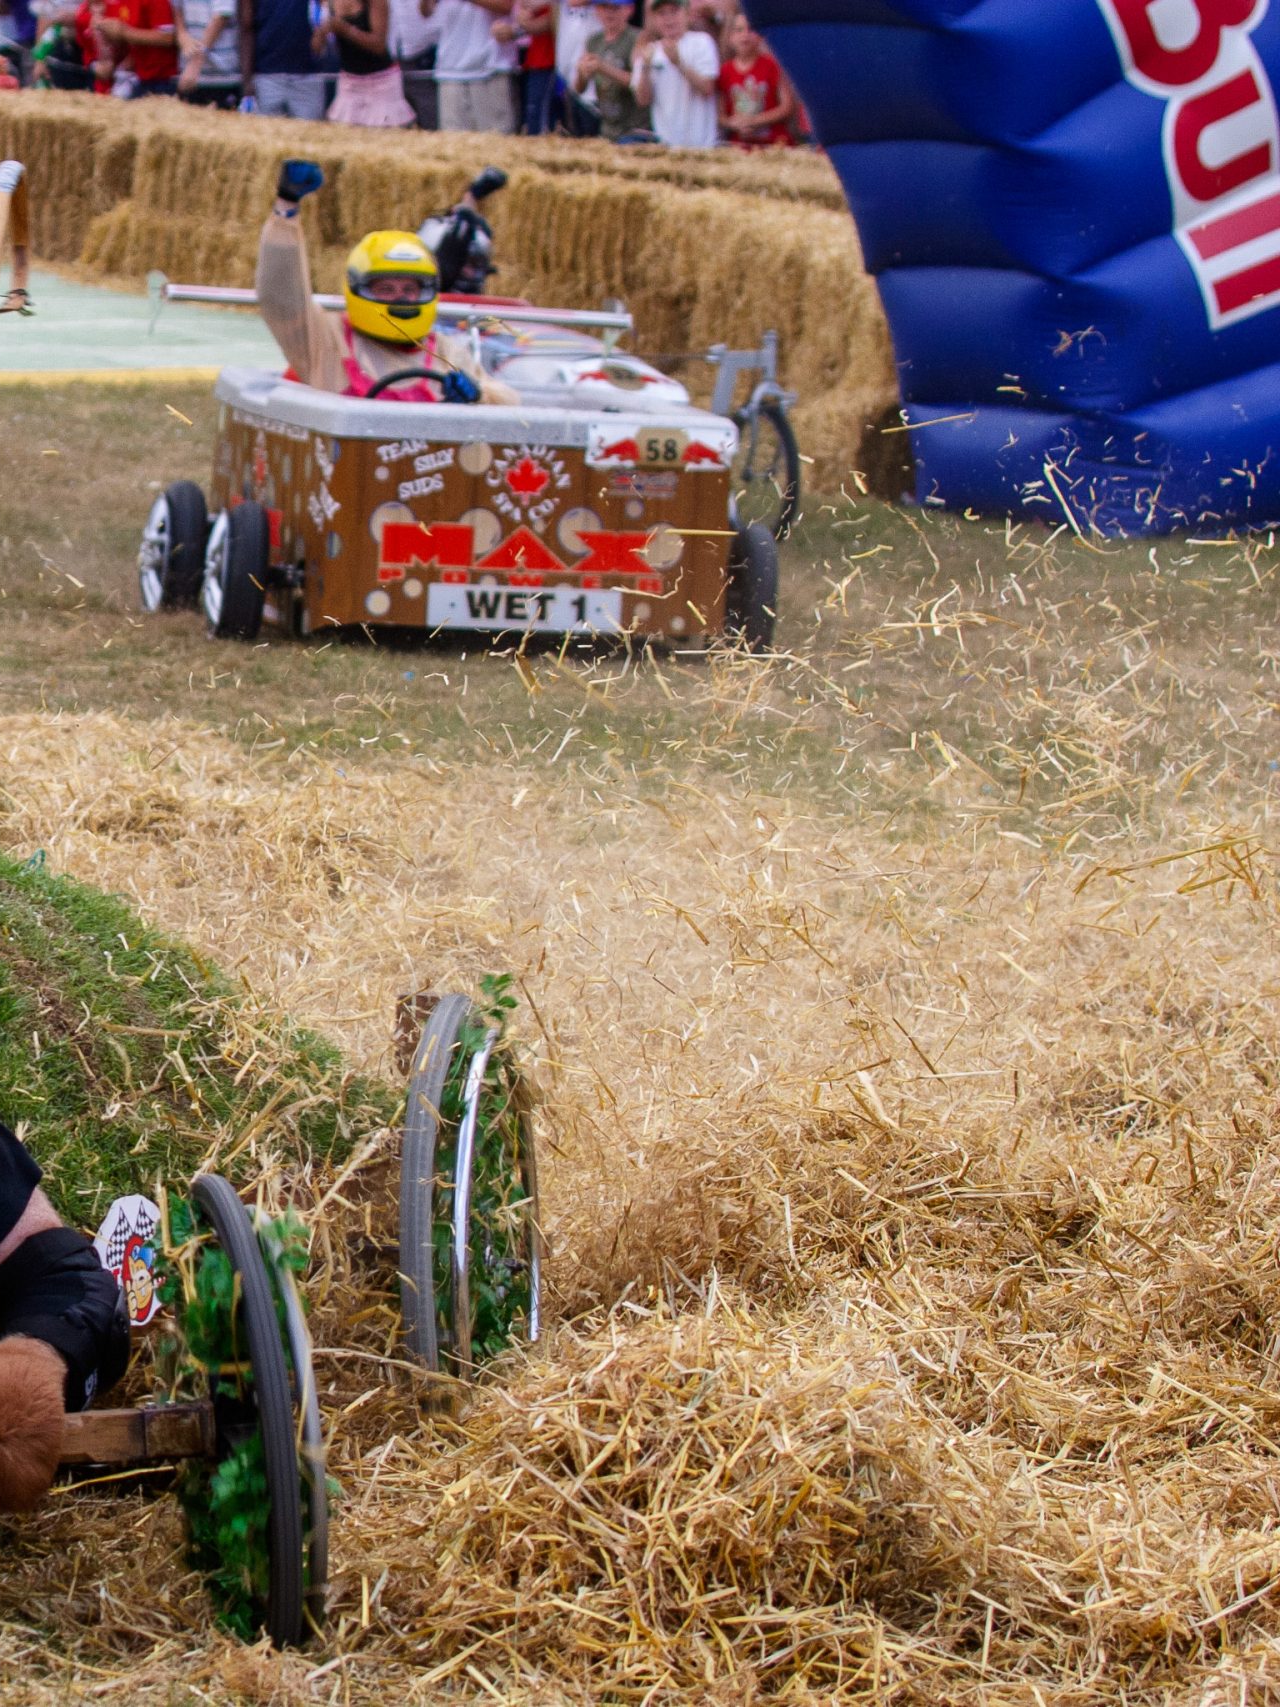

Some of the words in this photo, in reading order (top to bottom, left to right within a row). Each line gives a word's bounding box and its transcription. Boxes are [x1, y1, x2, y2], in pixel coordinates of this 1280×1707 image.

[376, 439, 428, 462] TEAM
[414, 448, 454, 474] SILLY
[646, 438, 677, 461] 58
[486, 443, 571, 489] CANADIAN
[398, 473, 444, 500] SUDS
[380, 521, 656, 574] MAX
[377, 567, 662, 594] POWER
[466, 590, 554, 621] WET
[572, 594, 587, 622] 1
